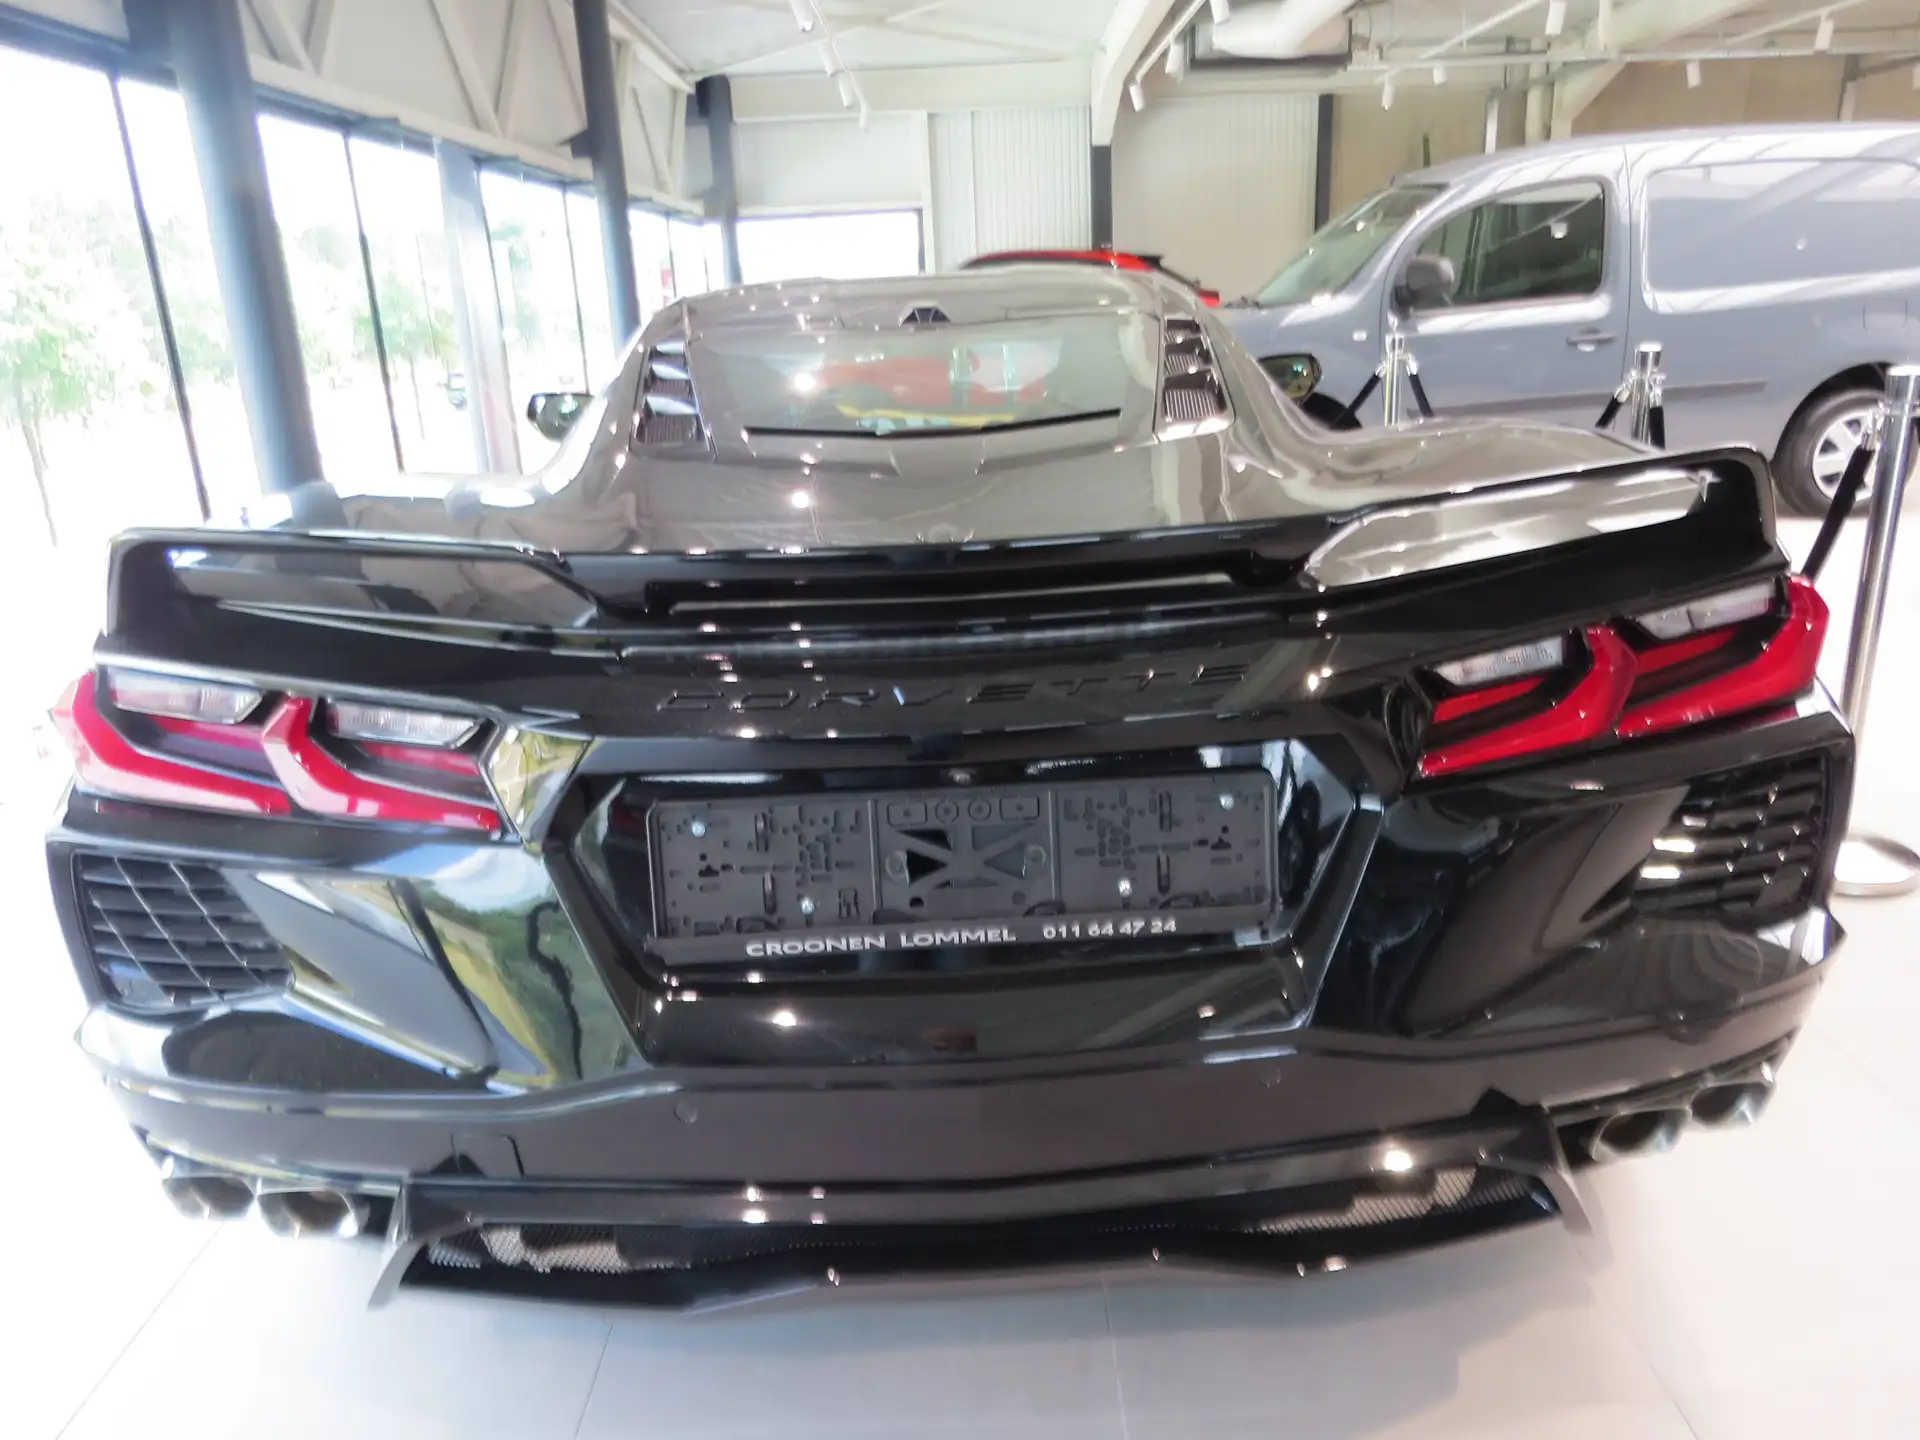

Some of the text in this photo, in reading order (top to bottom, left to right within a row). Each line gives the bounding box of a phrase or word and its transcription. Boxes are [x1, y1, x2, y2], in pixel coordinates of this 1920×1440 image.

[656, 664, 1249, 711] CORVETTE
[745, 917, 1177, 957] CROONEN LOMMEL 011 64 47 24
